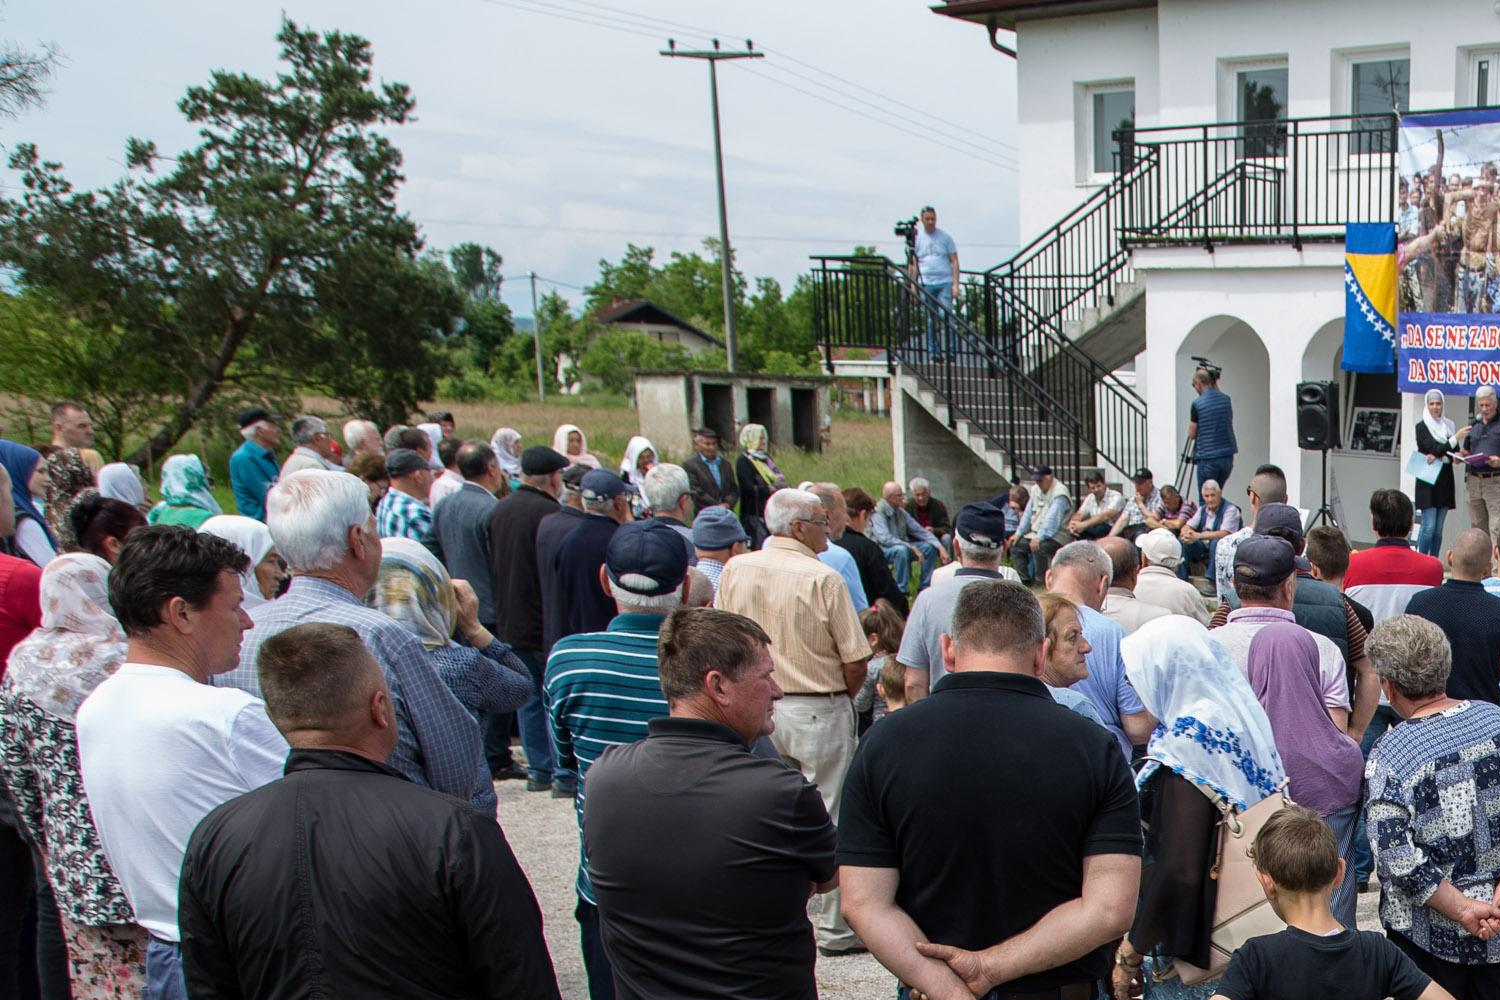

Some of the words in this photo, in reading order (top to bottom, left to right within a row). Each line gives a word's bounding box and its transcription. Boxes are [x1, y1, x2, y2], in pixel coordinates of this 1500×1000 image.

[1426, 325, 1443, 348] SE
[1446, 326, 1466, 349] NE
[1409, 359, 1427, 382] DA
[1428, 359, 1445, 382] SE
[1447, 360, 1467, 384] NE
